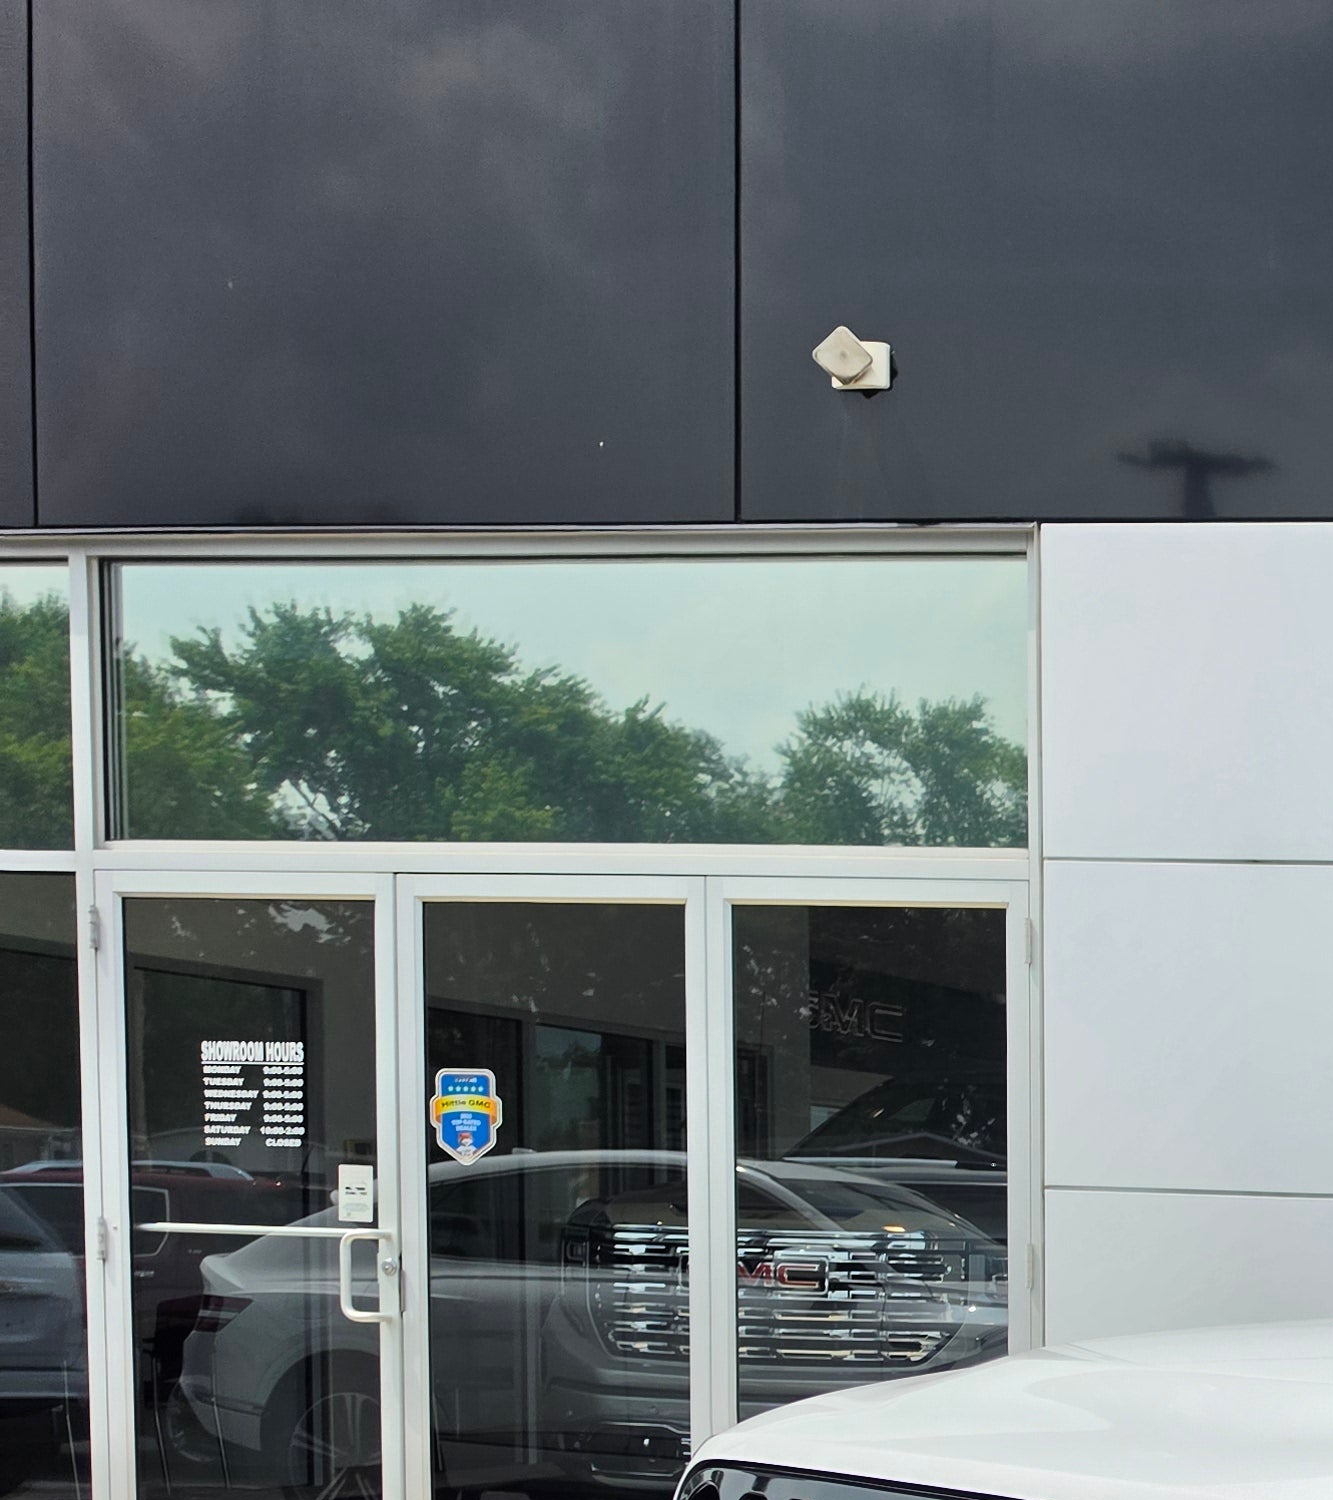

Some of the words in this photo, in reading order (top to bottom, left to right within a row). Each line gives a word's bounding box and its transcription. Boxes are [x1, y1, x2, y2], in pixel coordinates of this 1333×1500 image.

[201, 1040, 264, 1061] SHOWROOM
[265, 1041, 304, 1062] HOURS
[202, 1077, 245, 1086] TUESDAY
[203, 1089, 259, 1098] WEDNESDAY
[204, 1101, 252, 1110] THURSDAY
[469, 1099, 491, 1109] GMC
[204, 1113, 237, 1122] FRIDAY
[204, 1125, 251, 1134] SATURDAY
[205, 1137, 242, 1146] SUNDAY
[265, 1138, 302, 1147] CLOSED
[737, 1262, 820, 1288] MC
